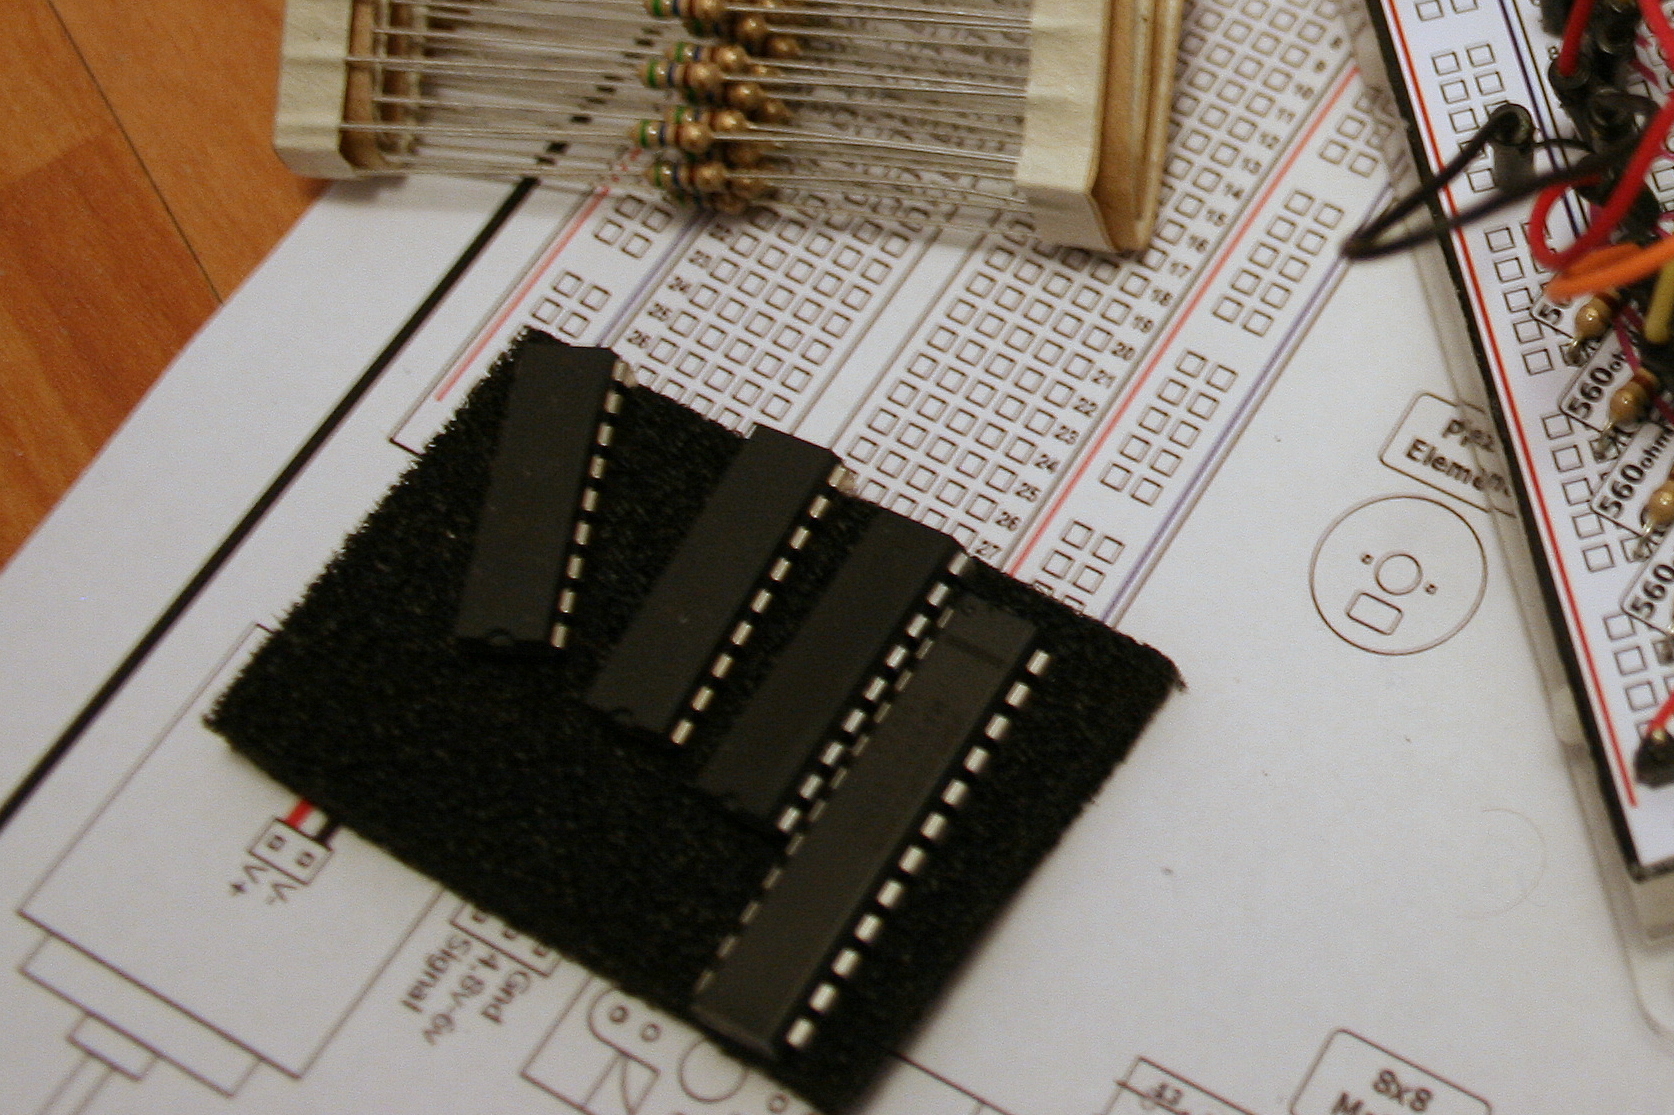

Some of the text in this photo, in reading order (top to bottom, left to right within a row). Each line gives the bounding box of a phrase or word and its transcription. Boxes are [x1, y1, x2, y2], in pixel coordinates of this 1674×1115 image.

[1168, 260, 1192, 280] 17
[646, 302, 673, 323] 25
[1132, 313, 1155, 334] 19
[626, 329, 652, 351] 26
[1111, 341, 1137, 362] 20
[1091, 368, 1117, 388] 21
[1567, 350, 1628, 417] 560oh
[1072, 395, 1099, 417] 22
[1054, 423, 1080, 444] 23
[1034, 451, 1060, 473] 24
[1600, 432, 1671, 519] 560ohm
[1014, 479, 1041, 502] 25
[995, 508, 1022, 532] 26
[975, 537, 1001, 561] 27
[401, 934, 472, 1014] Signal
[480, 969, 532, 1024] Gnd
[1372, 1068, 1434, 1114] 8x8
